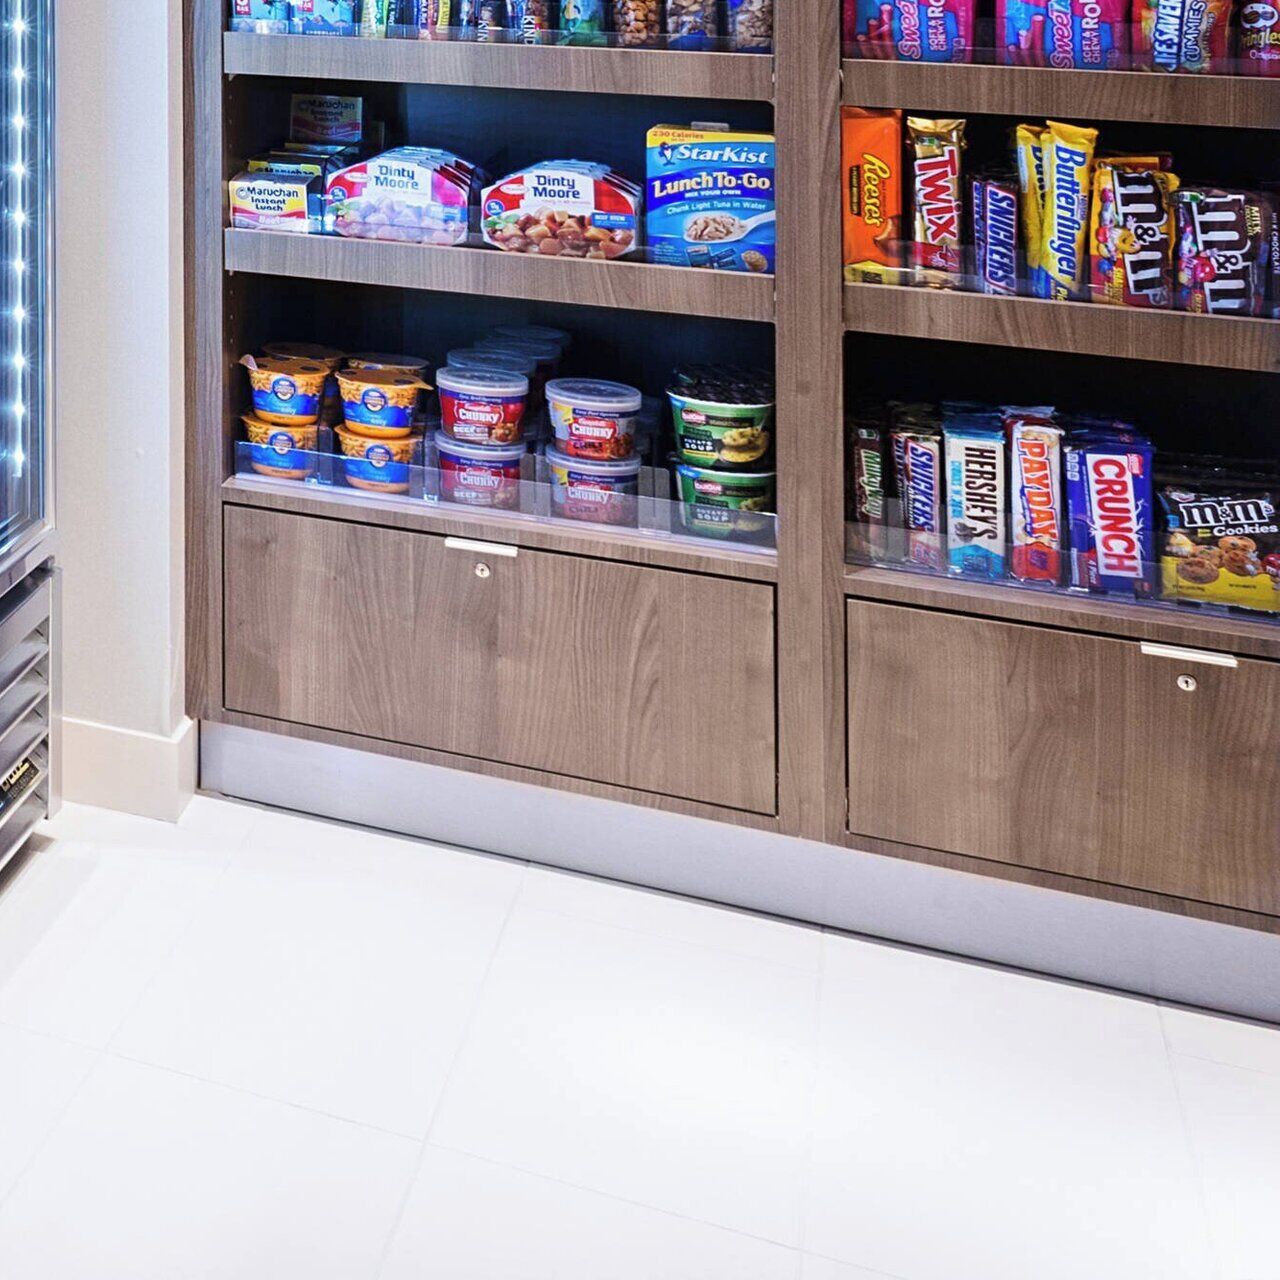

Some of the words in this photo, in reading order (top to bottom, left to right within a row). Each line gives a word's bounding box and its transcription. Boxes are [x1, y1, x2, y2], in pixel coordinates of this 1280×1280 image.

[523, 15, 536, 45] KIND
[1186, 1, 1207, 62] GUMMIES
[671, 131, 704, 140] Calories
[677, 143, 769, 165] StarKist
[375, 176, 419, 190] Moore
[380, 165, 416, 179] Dinty
[535, 174, 576, 189] Dinty
[653, 173, 710, 199] Lunch
[713, 171, 771, 190] To-Go
[247, 186, 299, 198] Maruchan
[251, 197, 287, 205] Instant
[532, 186, 581, 199] Moore
[685, 191, 697, 199] MIX
[699, 190, 721, 198] YOUR
[722, 189, 741, 197] OWN
[863, 153, 890, 228] Reese's
[917, 149, 959, 243] TWIX
[667, 204, 690, 216] Chunk
[691, 201, 711, 212] Light
[713, 201, 732, 210] Tuna
[733, 201, 741, 210] in
[743, 201, 767, 211] Water
[1050, 144, 1087, 282] Butterfinger
[1251, 206, 1261, 234] MILK
[988, 187, 1016, 291] SNICKERS
[909, 444, 935, 533] SNICKERS
[965, 447, 998, 540] HERSHEY'S
[1019, 438, 1059, 542] PAYDAY
[1092, 458, 1139, 575] CRUNCH
[1182, 500, 1275, 527] m&m's
[1213, 524, 1278, 536] Cookies
